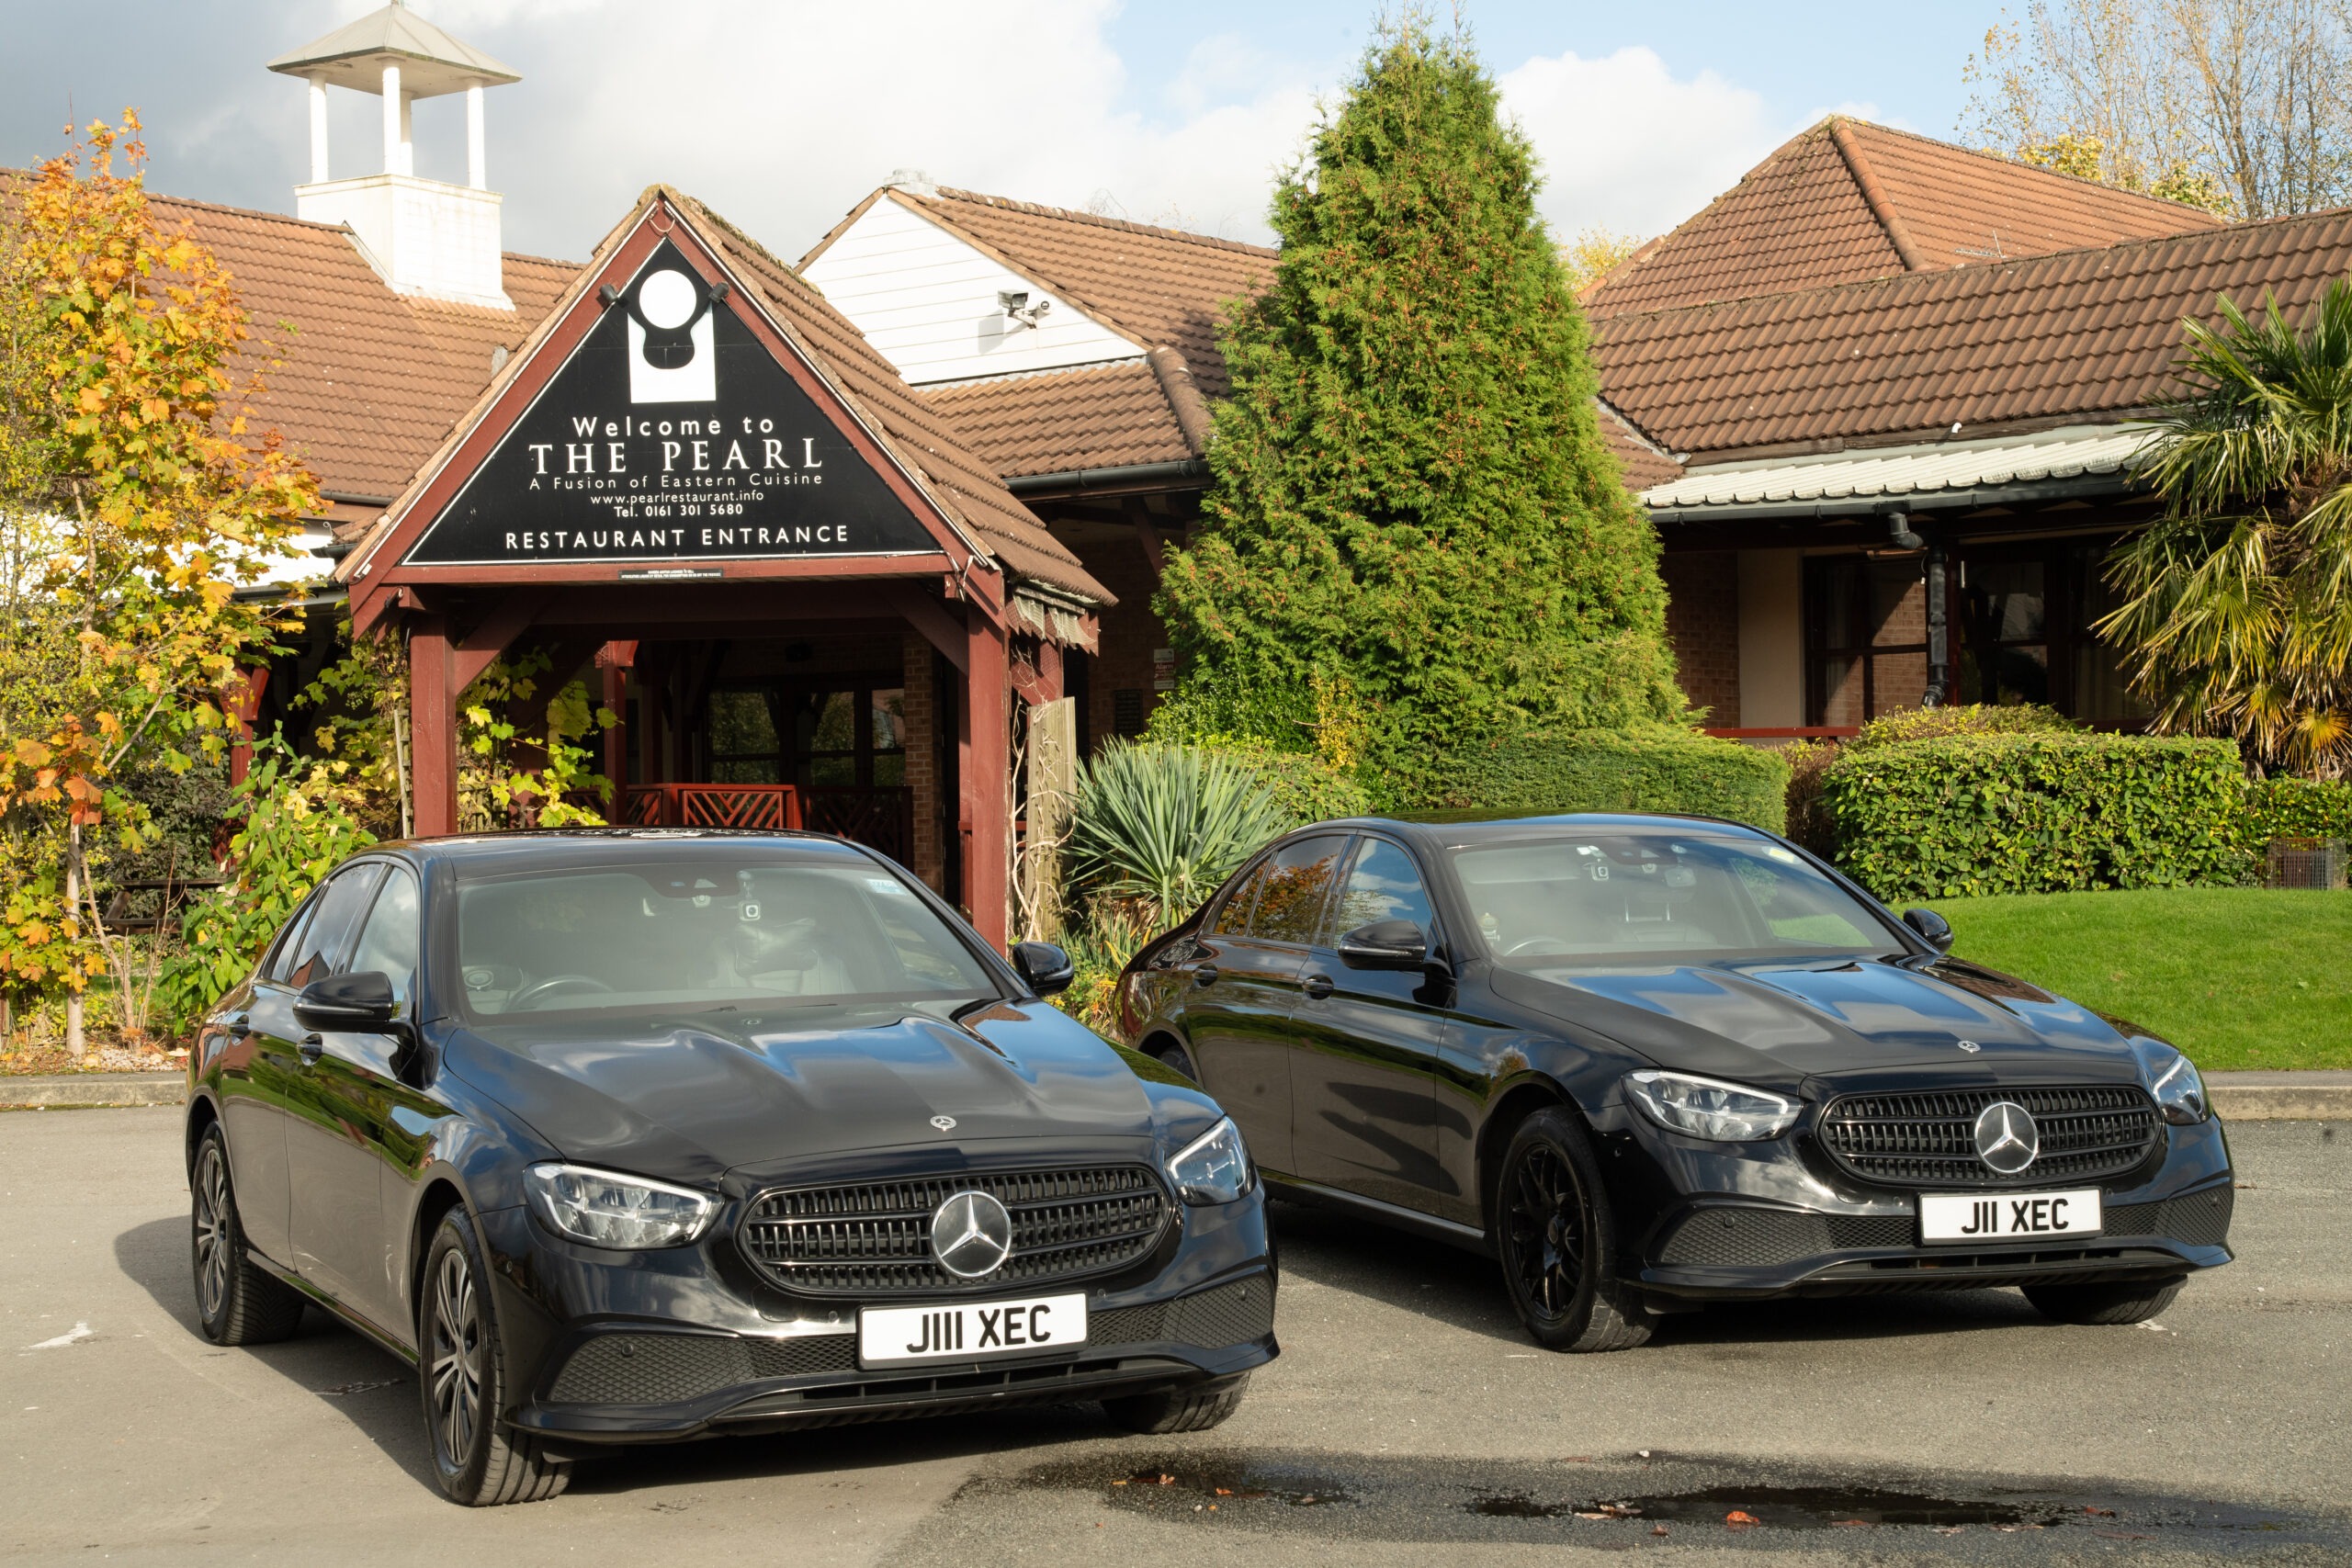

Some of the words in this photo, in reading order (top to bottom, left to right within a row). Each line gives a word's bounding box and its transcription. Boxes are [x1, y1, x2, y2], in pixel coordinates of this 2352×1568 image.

[572, 416, 720, 437] Welcome
[742, 417, 773, 434] to
[529, 443, 626, 474] THE
[662, 438, 821, 471] PEARL
[529, 478, 540, 490] A
[554, 477, 616, 490] Fusion
[630, 476, 647, 488] of
[662, 475, 735, 487] Eastern
[750, 472, 821, 485] Cuisine
[590, 490, 763, 506] www.pearlrestaurant.info
[614, 506, 638, 517] Tel.
[646, 505, 671, 516] 0161
[681, 504, 700, 515] 301
[710, 503, 742, 515] 5680
[506, 529, 684, 548] RESTAURANT
[702, 525, 847, 545] ENTRANCE
[2011, 1198, 2069, 1232] XEC
[978, 1304, 1051, 1348] XEC
